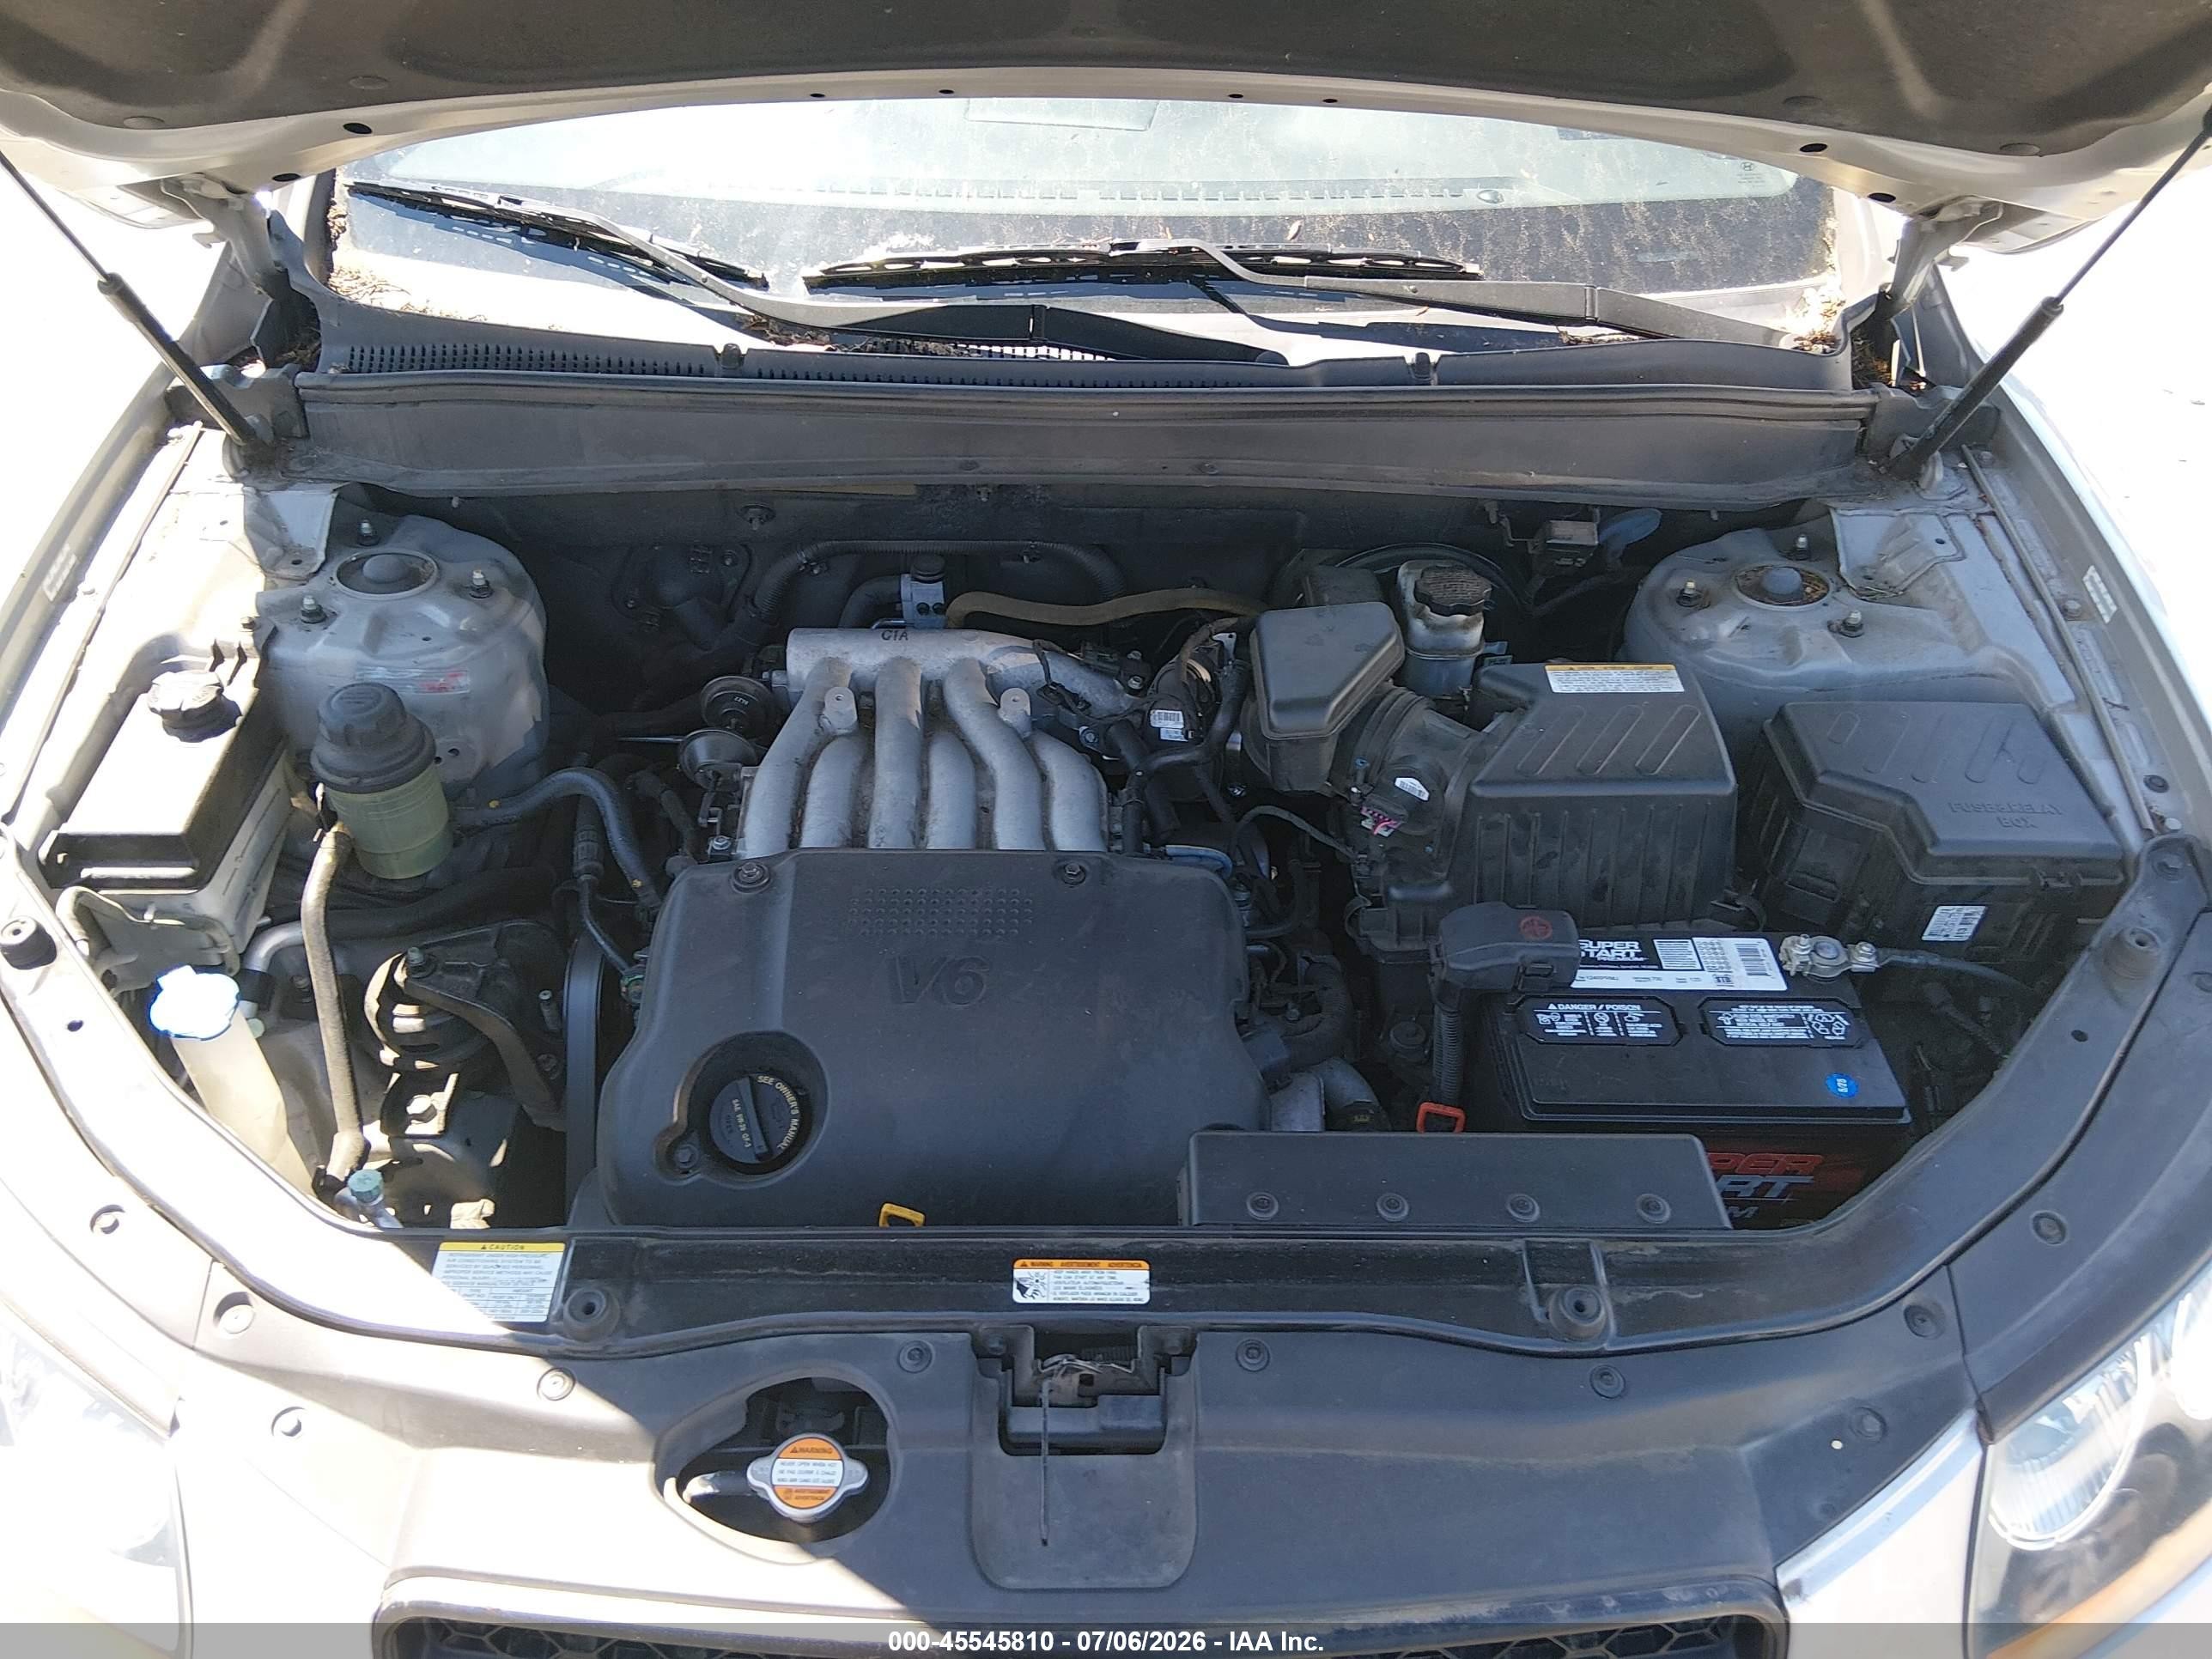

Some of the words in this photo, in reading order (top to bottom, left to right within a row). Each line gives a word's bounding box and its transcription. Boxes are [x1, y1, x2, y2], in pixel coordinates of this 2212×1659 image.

[1997, 816, 2039, 830] BOX
[1579, 939, 1639, 950] SUPER
[884, 955, 990, 1006] V6
[757, 1075, 775, 1086] SEE
[775, 1082, 800, 1115] OWNER'S
[776, 1118, 799, 1151] MANUAL
[1706, 1152, 1825, 1175] PER
